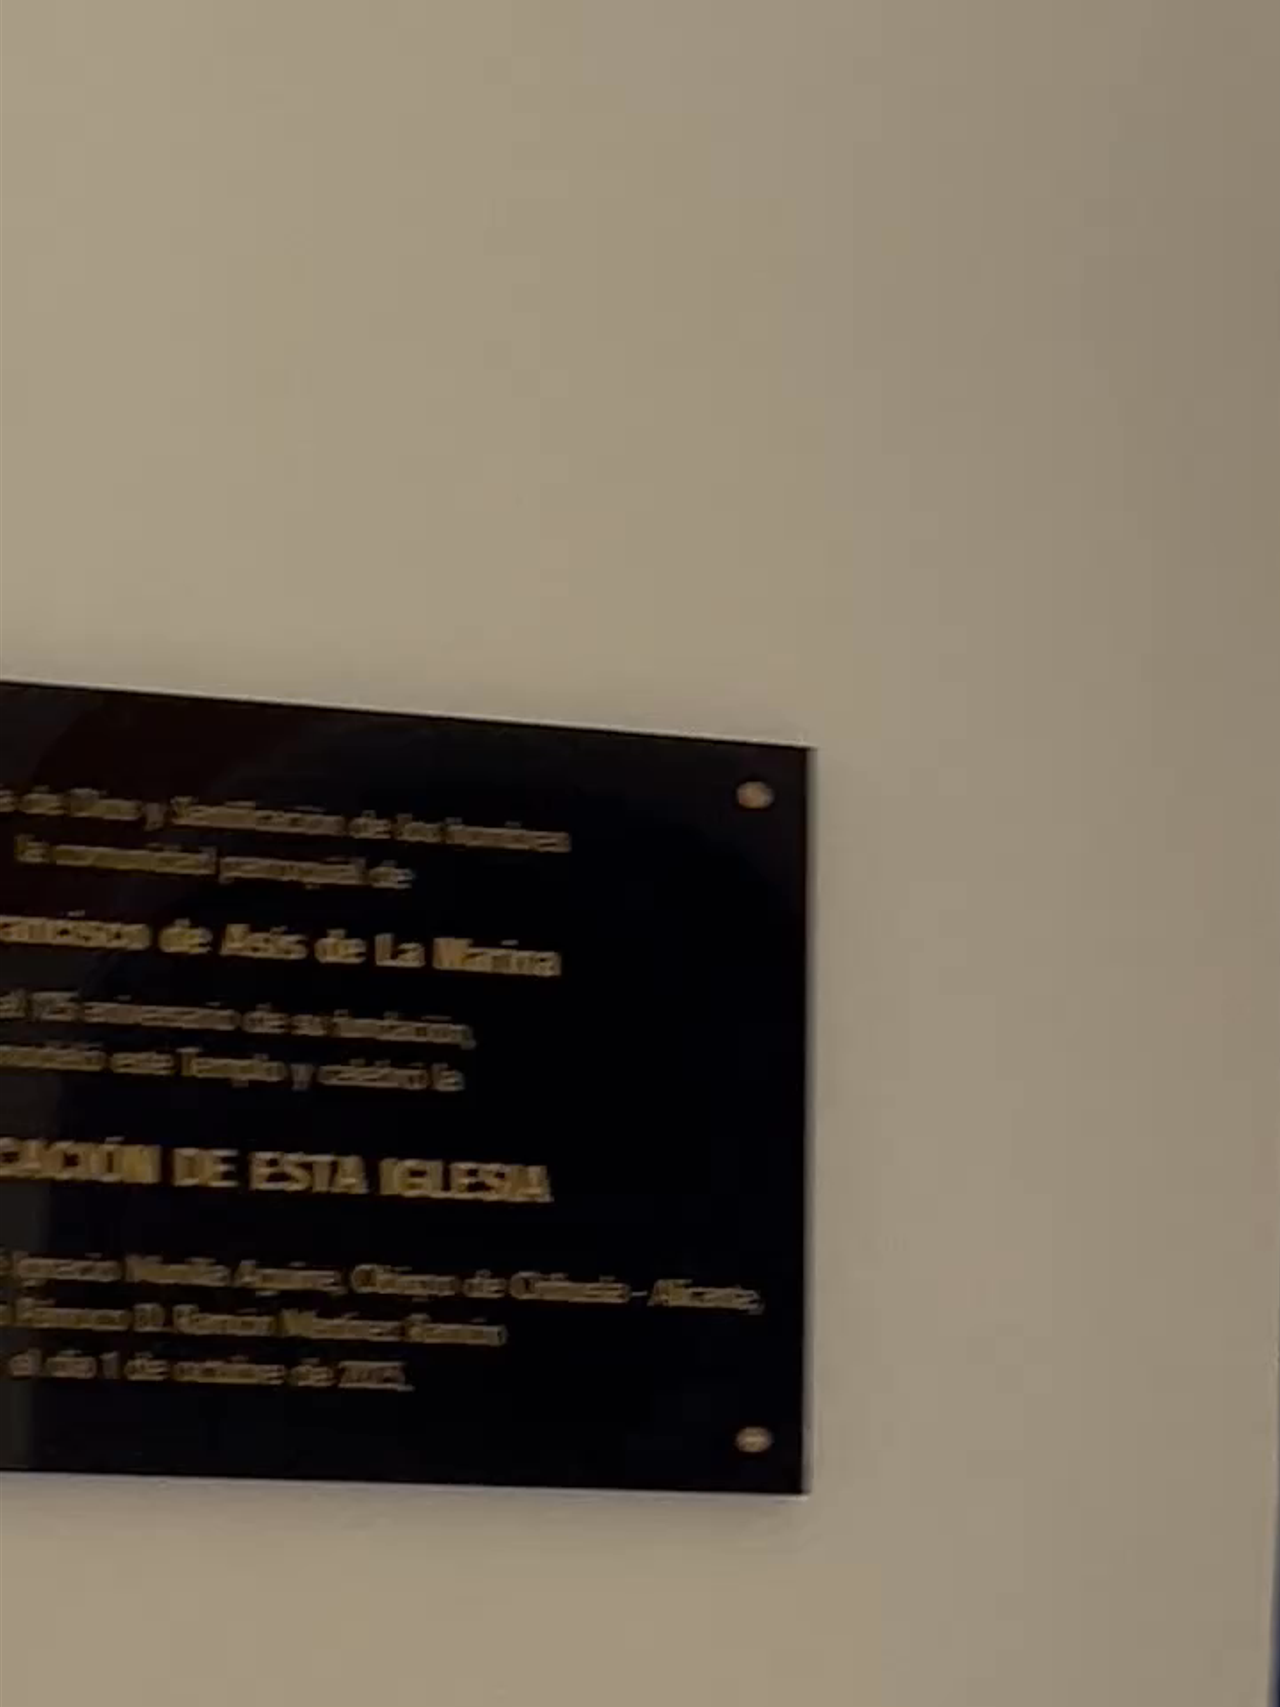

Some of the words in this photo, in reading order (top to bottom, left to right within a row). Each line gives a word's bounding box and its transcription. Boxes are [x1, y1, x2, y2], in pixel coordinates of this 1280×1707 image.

[348, 809, 391, 840] de
[369, 860, 416, 889] de
[0, 910, 152, 951] ancisco
[158, 918, 213, 954] de
[219, 924, 308, 960] Asís
[314, 928, 367, 965] de
[374, 933, 425, 969] La
[432, 937, 561, 977] Marina
[242, 1003, 289, 1034] de
[291, 1014, 331, 1036] su
[110, 1051, 174, 1075] este
[290, 1063, 314, 1092] y
[0, 1136, 161, 1184] CACIÓN
[171, 1147, 240, 1187] DE
[249, 1151, 368, 1195] ESTA
[379, 1157, 554, 1203] IGLESIA
[462, 1269, 506, 1299] de
[123, 1351, 170, 1381] de
[289, 1357, 336, 1387] de
